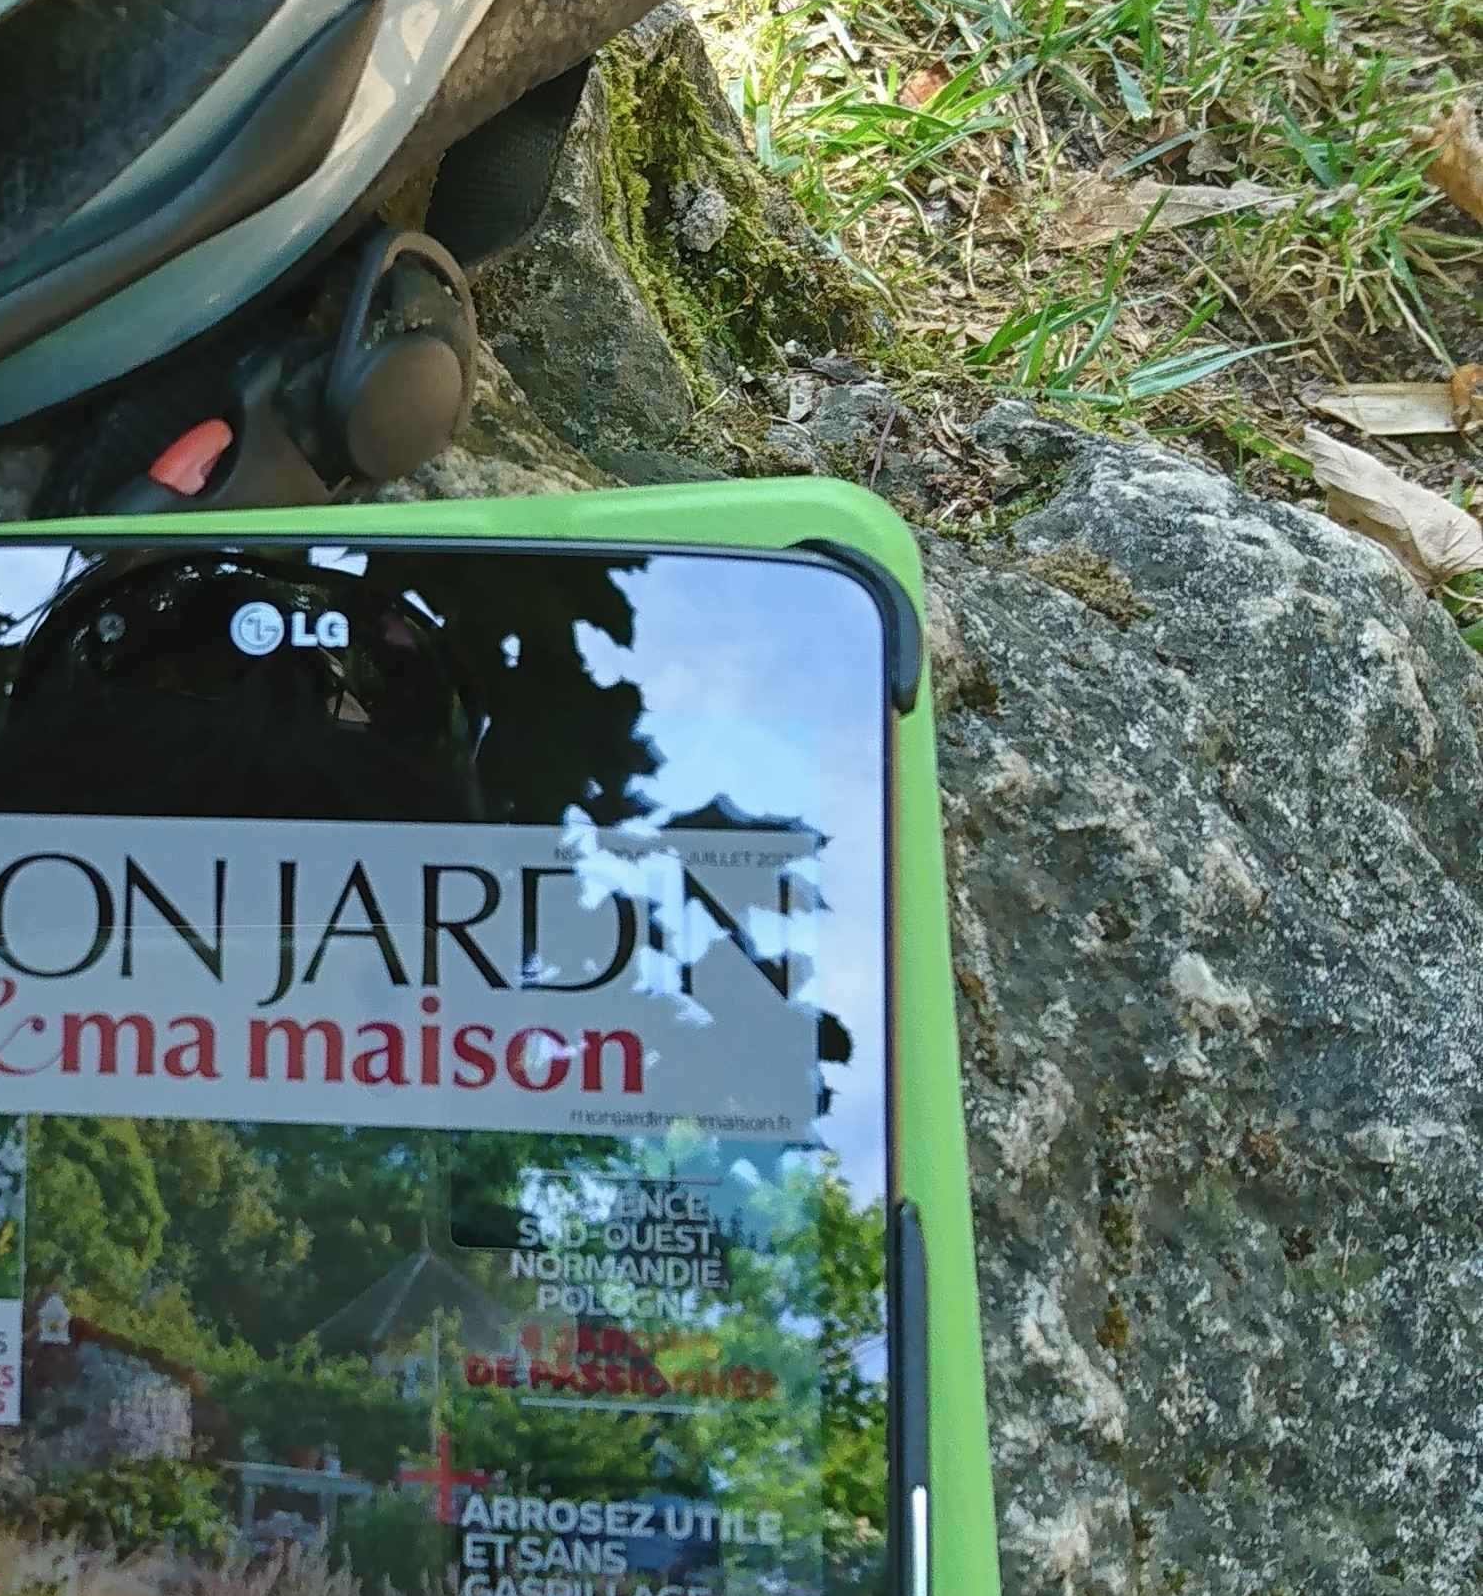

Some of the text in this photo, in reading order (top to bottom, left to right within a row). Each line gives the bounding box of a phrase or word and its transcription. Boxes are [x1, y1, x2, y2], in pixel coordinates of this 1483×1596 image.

[291, 610, 350, 648] LG
[248, 997, 646, 1096] maison
[462, 1492, 784, 1547] ARROSEZ UTILE
[463, 1531, 628, 1575] ET SANS
